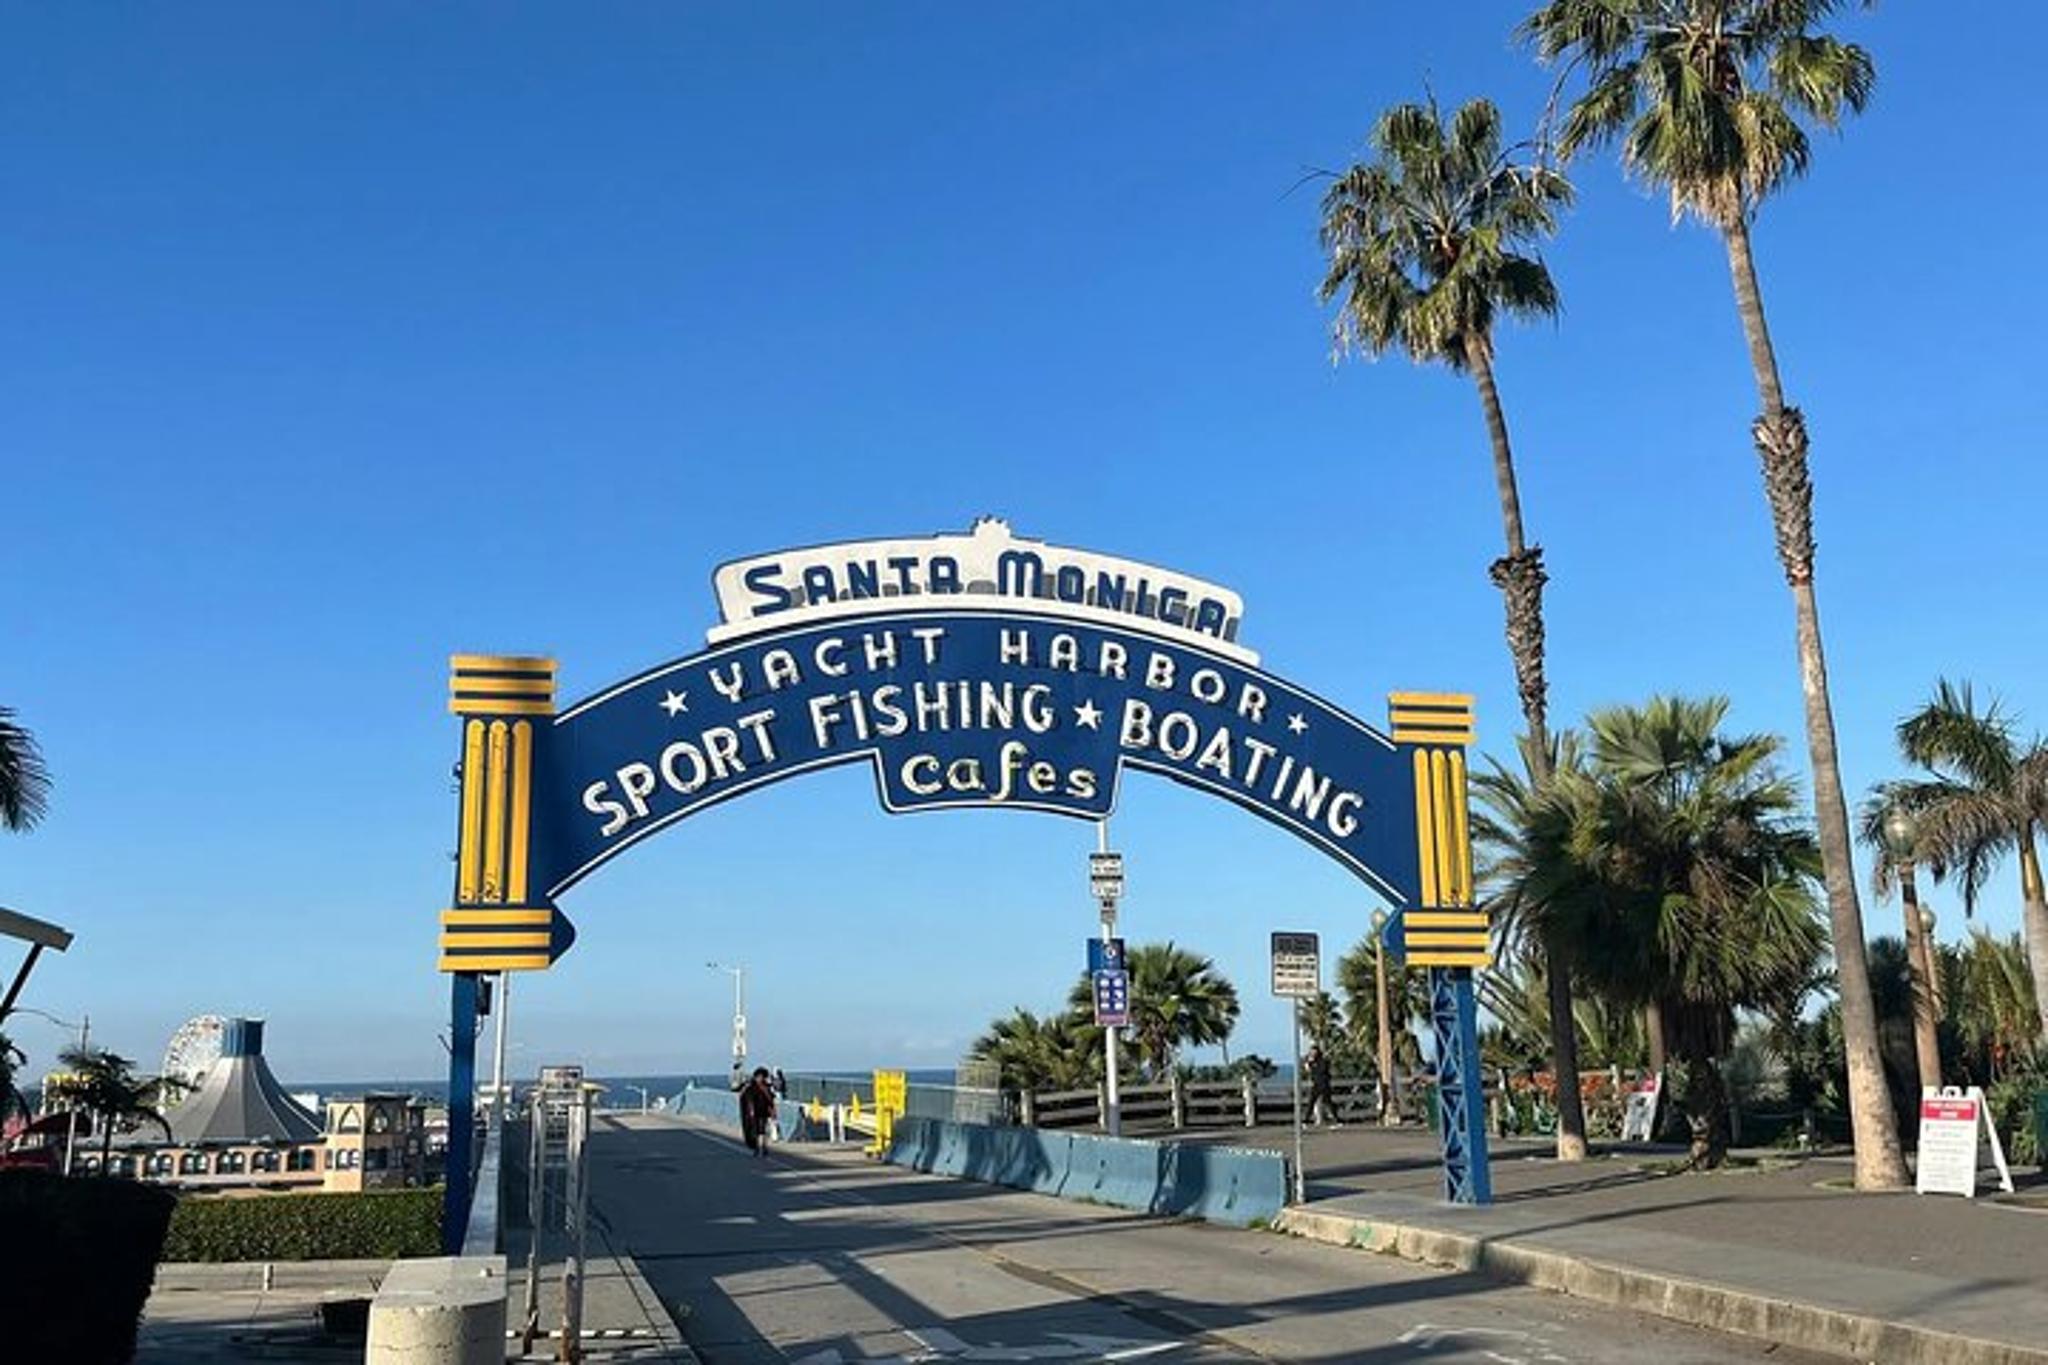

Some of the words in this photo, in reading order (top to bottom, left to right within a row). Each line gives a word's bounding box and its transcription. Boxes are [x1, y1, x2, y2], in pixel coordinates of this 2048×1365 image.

[744, 556, 960, 617] SANTA
[998, 550, 1227, 641] MONICA
[708, 627, 945, 703] YACHT
[1000, 629, 1267, 724] HARBOR
[582, 710, 776, 838] SPORT
[809, 680, 1055, 750] FISHING
[1119, 698, 1364, 838] BOATING
